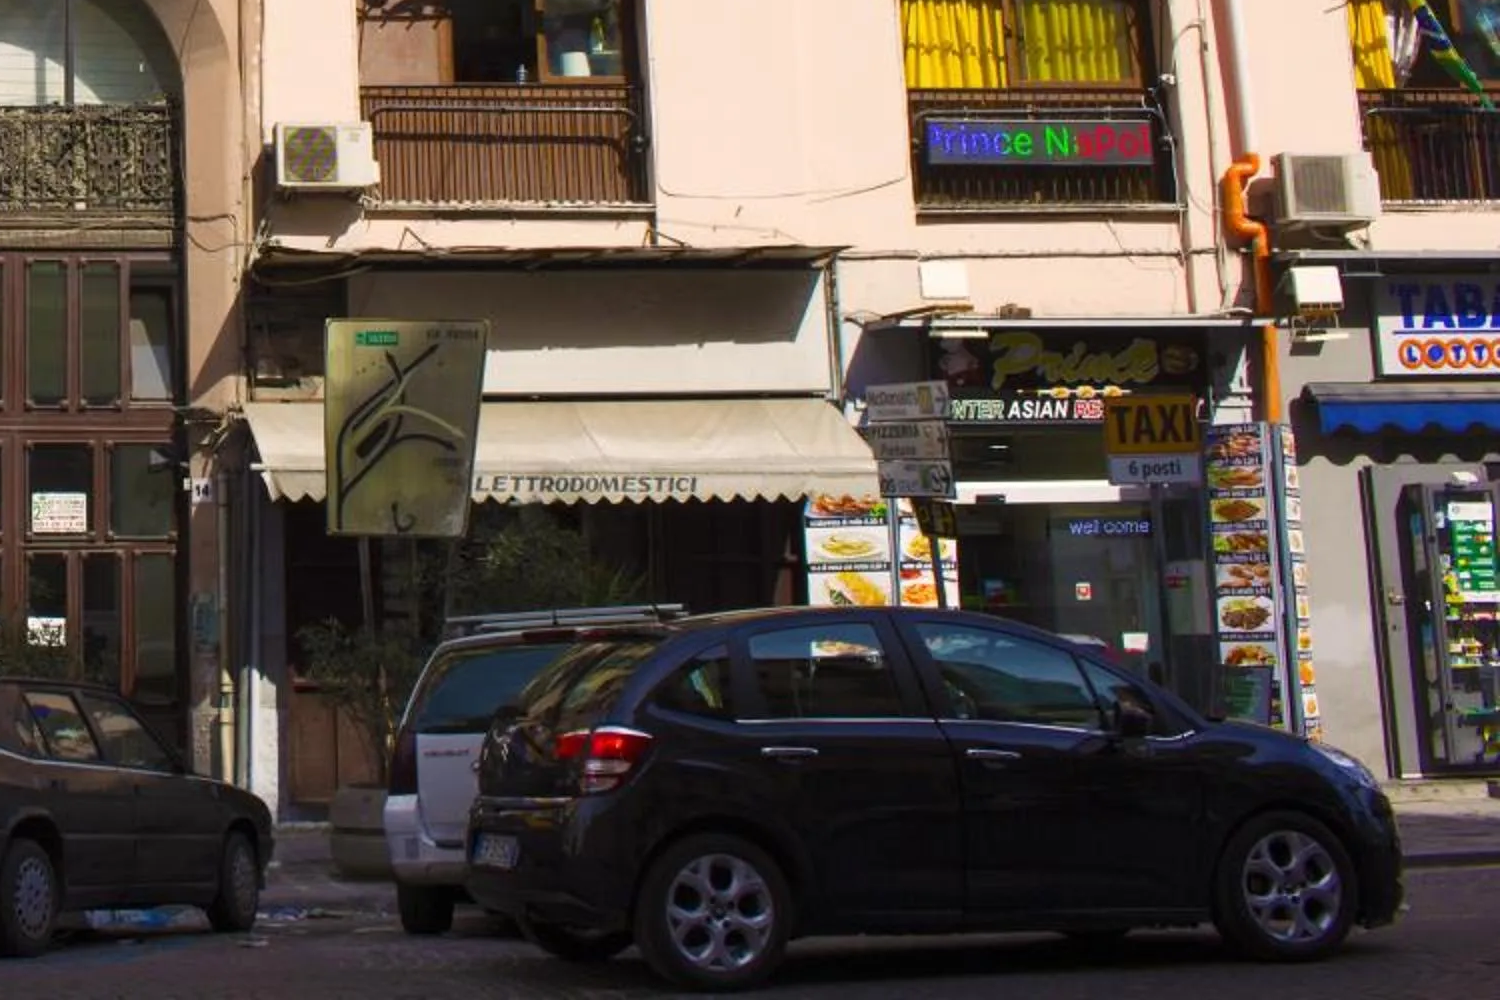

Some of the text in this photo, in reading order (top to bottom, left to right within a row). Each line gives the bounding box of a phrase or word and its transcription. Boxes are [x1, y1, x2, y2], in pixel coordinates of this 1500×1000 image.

[952, 399, 1004, 419] NTER
[1007, 400, 1069, 419] ASIAN
[1110, 403, 1194, 444] TAXI
[1128, 459, 1182, 479] 6 posti
[475, 475, 698, 493] LETTRODOMESTICI
